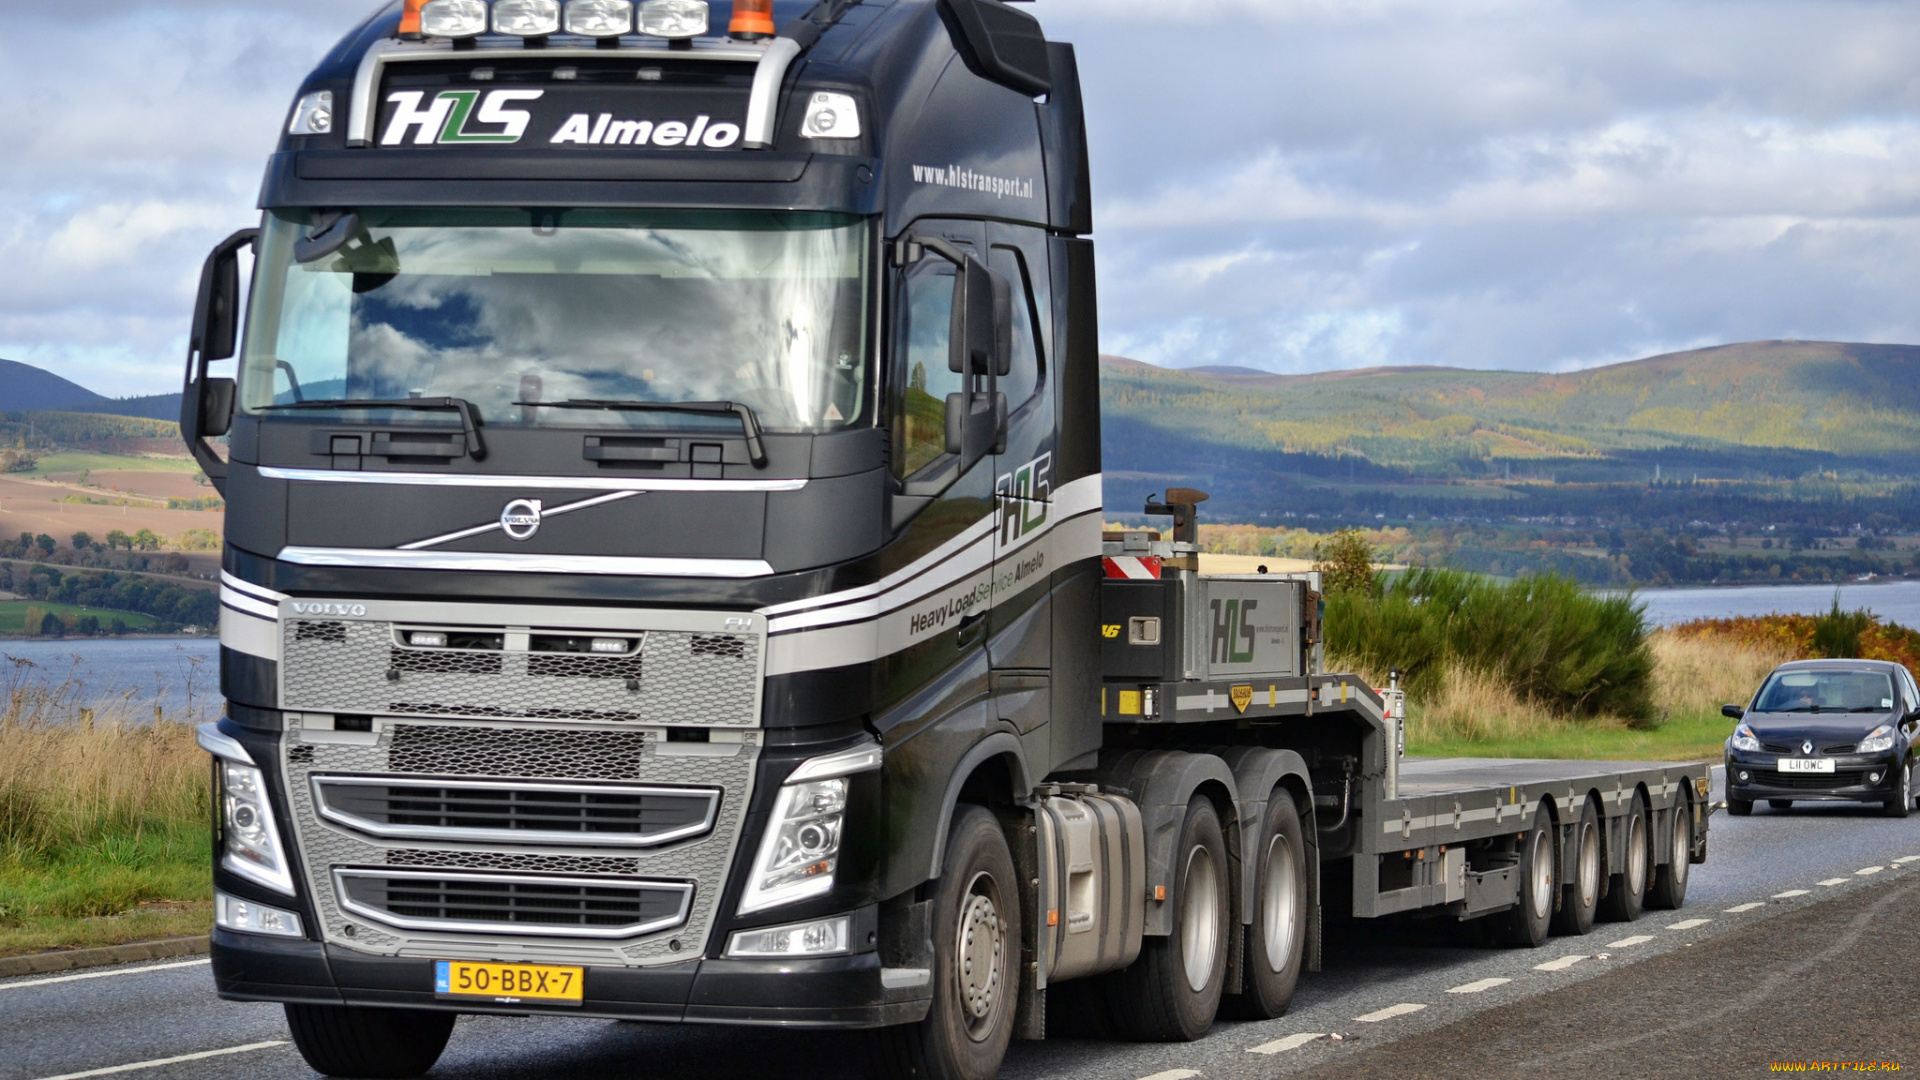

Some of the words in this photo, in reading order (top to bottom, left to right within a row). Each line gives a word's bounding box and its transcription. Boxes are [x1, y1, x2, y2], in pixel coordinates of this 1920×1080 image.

[381, 90, 544, 145] HLS
[550, 113, 740, 147] Almelo
[913, 164, 1033, 199] www.hlstransport.nl
[504, 516, 538, 524] VOLVO
[1014, 550, 1044, 583] Almelo
[291, 602, 367, 617] VOLVO
[724, 617, 752, 630] FH
[1210, 599, 1258, 664] HLS
[438, 980, 448, 988] NL
[459, 967, 573, 993] 50-BBX-7
